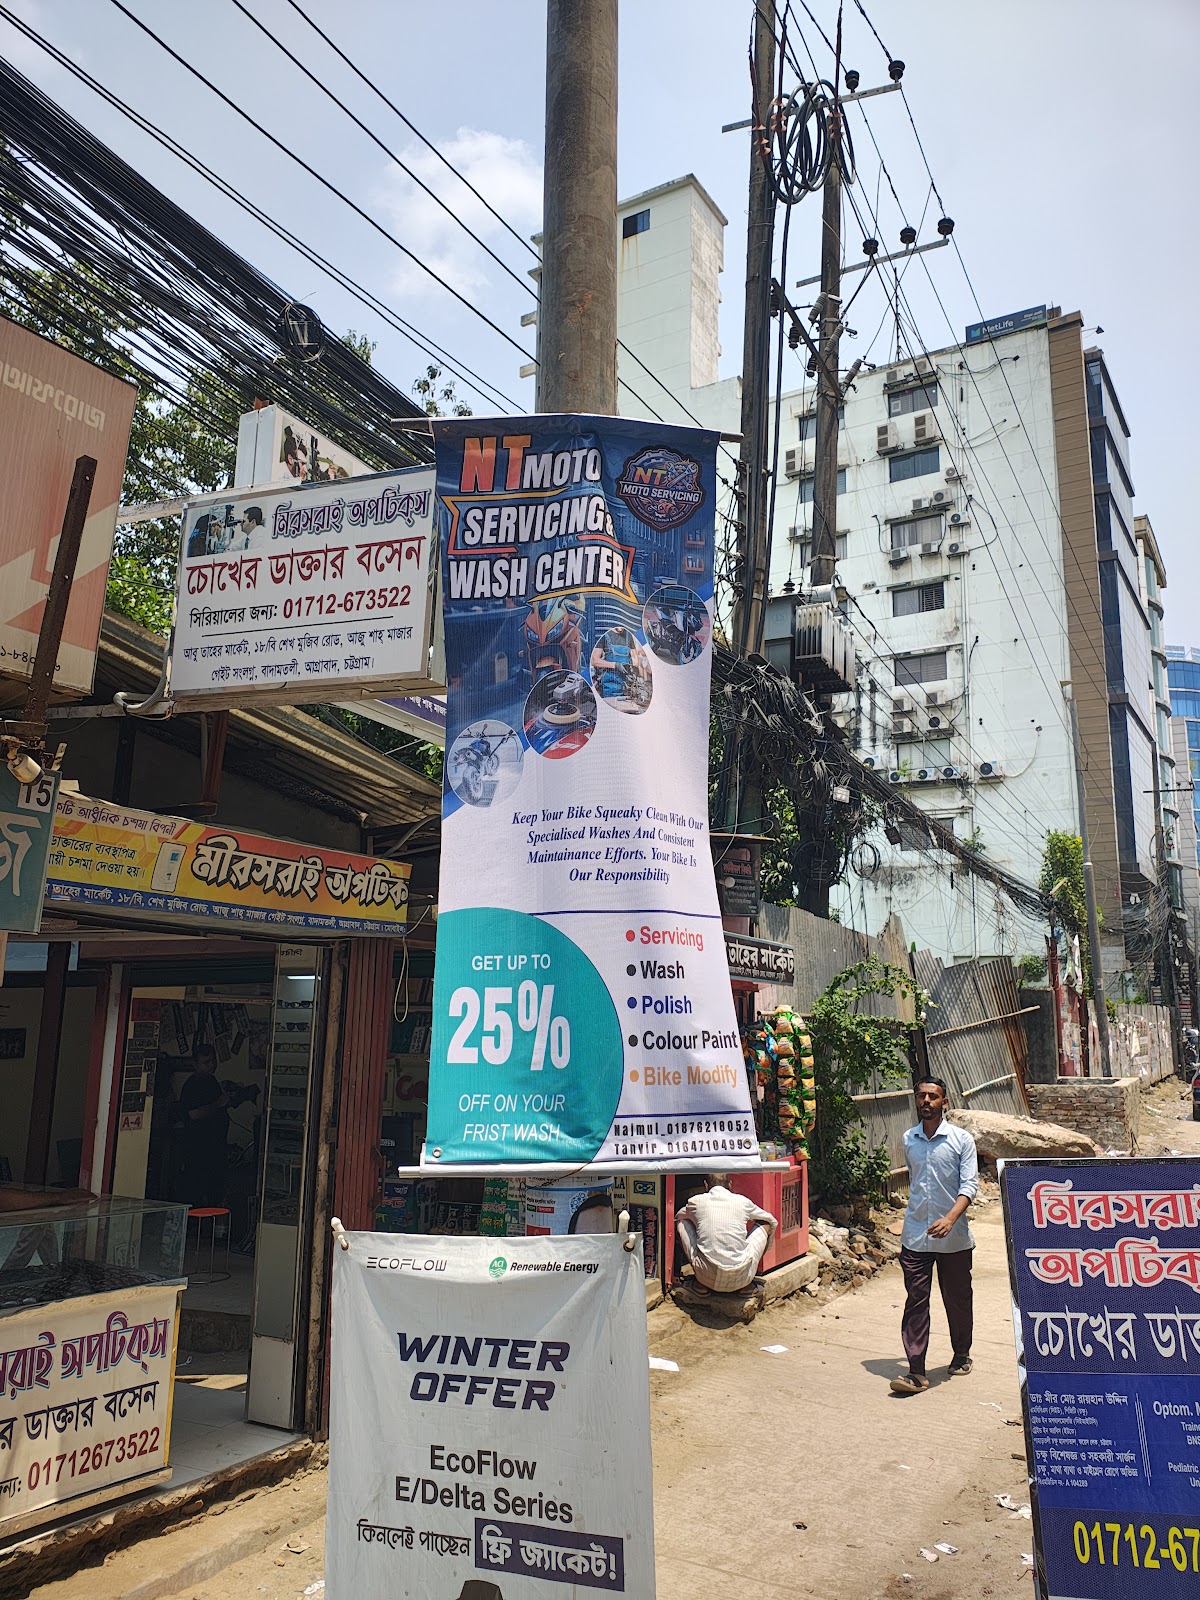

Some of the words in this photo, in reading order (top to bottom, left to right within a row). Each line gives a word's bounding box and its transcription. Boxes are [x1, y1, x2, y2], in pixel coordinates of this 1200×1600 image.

[982, 319, 1014, 334] MetLife
[461, 434, 531, 493] NT
[522, 448, 601, 489] MOTO
[633, 467, 667, 486] NT
[622, 484, 650, 496] MOTO
[651, 487, 700, 502] SERVICING
[272, 498, 345, 539] মিরসরাই
[186, 555, 262, 595] চোখের
[268, 543, 349, 585] ডাক্তার
[355, 536, 427, 576] বসেন
[450, 557, 529, 599] WASH
[535, 546, 625, 593] CENTER
[189, 606, 245, 628] সিরিয়ালের
[283, 585, 411, 618] 01712-673522
[183, 647, 197, 662] আবু
[201, 643, 222, 659] তাহের
[225, 640, 251, 657] মার্কেট,
[254, 637, 276, 653] ১৮/বি
[279, 637, 296, 651] শেখ
[297, 633, 319, 652] মুজিব
[321, 633, 343, 648] রোড,
[347, 630, 366, 647] আজু
[387, 626, 413, 641] মাজার
[211, 664, 230, 682] গেইট
[261, 658, 300, 676] বাদামতলী,
[304, 659, 339, 674] আগ্রাবাদ,
[77, 806, 121, 825] আধুনিক
[122, 814, 148, 830] চশমা
[512, 811, 538, 826] Keep
[541, 809, 564, 822] Your
[566, 806, 591, 819] Bike
[595, 806, 643, 822] Squeaky
[646, 806, 668, 823] Clean
[669, 812, 686, 828] With
[688, 816, 704, 831] Our
[527, 826, 586, 846] Specialised
[589, 826, 630, 840] Washes
[633, 826, 655, 840] And
[657, 828, 695, 848] Consistent
[68, 856, 94, 871] চশমা
[96, 861, 124, 875] দেওয়া
[527, 848, 601, 864] Maintainance
[605, 847, 647, 863] Efforts.
[651, 847, 670, 862] Your
[672, 851, 688, 866] Bike
[690, 855, 697, 867] Is
[191, 834, 323, 901] মীরসরাই
[325, 863, 409, 910] অপটিক
[569, 868, 592, 882] Our
[595, 868, 670, 885] Responsibility
[52, 883, 81, 897] তাহের
[83, 888, 114, 904] মার্কেট,
[148, 897, 166, 908] শেখ
[167, 898, 188, 913] মুজিব
[190, 903, 209, 915] রোড,
[212, 905, 230, 918] আজু
[246, 909, 267, 921] মাজার
[268, 911, 287, 922] গেইট
[639, 925, 704, 952] Servicing
[471, 955, 503, 971] GET
[507, 954, 530, 970] UP
[531, 953, 551, 969] TO
[640, 960, 685, 980] Wash
[729, 939, 759, 967] তাহের
[760, 945, 794, 974] মার্কেট
[642, 994, 693, 1015] Polish
[447, 979, 571, 1071] 25%
[643, 1030, 698, 1051] Colour
[701, 1030, 739, 1051] Paint
[643, 1066, 683, 1087] Bike
[687, 1066, 738, 1089] Modify
[459, 1094, 490, 1112] OFF
[493, 1094, 518, 1112] ON
[522, 1093, 566, 1112] YOUR
[122, 1115, 141, 1129] A-4
[463, 1123, 510, 1142] FRIST
[513, 1123, 562, 1142] WASH
[636, 1183, 654, 1194] C-2
[1027, 1179, 1200, 1231] মিরসরা
[366, 1256, 448, 1272] ECOFLOW
[491, 1259, 505, 1268] ACI
[510, 1261, 561, 1273] Renewable
[563, 1261, 599, 1275] Energy
[1025, 1236, 1200, 1293] অপটিক
[61, 1310, 170, 1379] অপটিক্স
[1027, 1304, 1138, 1362] চোখের
[396, 1332, 571, 1372] WINTER
[409, 1371, 556, 1411] OFFER
[24, 1397, 98, 1442] ডাক্তার
[103, 1381, 159, 1422] বসেন
[1153, 1400, 1193, 1419] Optom.
[27, 1426, 160, 1491] 01712673522
[430, 1444, 537, 1480] EcoFlow
[1168, 1461, 1199, 1473] Pediatric
[395, 1475, 486, 1512] E/Delta
[493, 1487, 573, 1524] Series
[357, 1519, 415, 1550] কিনলেই
[420, 1530, 471, 1557] পাচ্ছেন
[480, 1524, 514, 1566] ফ্রি
[519, 1542, 617, 1581] জ্যাকেট!
[1073, 1520, 1200, 1572] 01712-67
